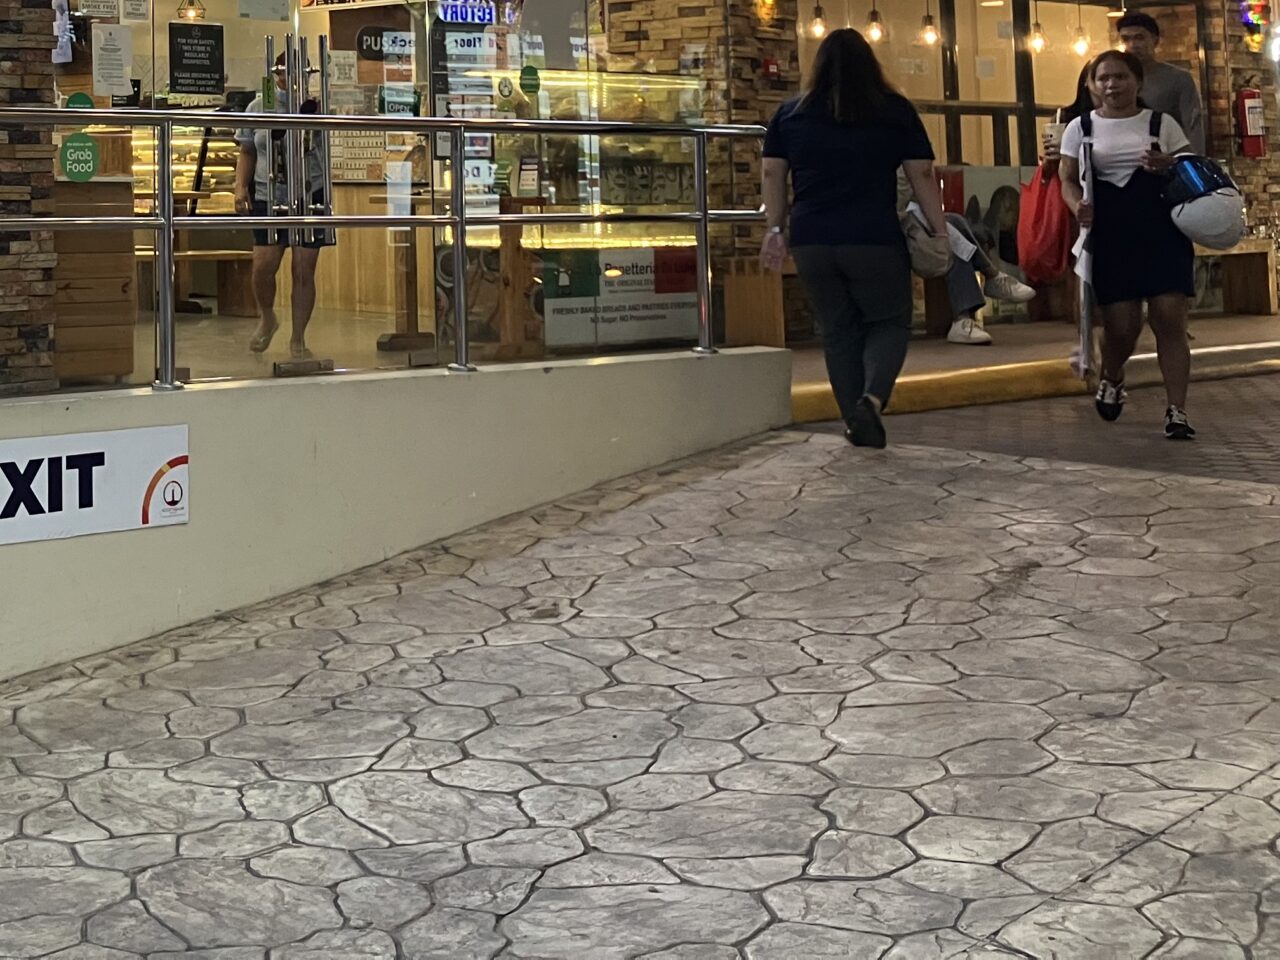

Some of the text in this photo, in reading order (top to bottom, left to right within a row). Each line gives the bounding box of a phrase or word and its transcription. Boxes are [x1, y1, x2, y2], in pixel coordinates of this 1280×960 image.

[363, 36, 394, 51] PUS
[389, 103, 410, 113] OPEN
[67, 148, 92, 160] Grab
[67, 160, 93, 172] Food
